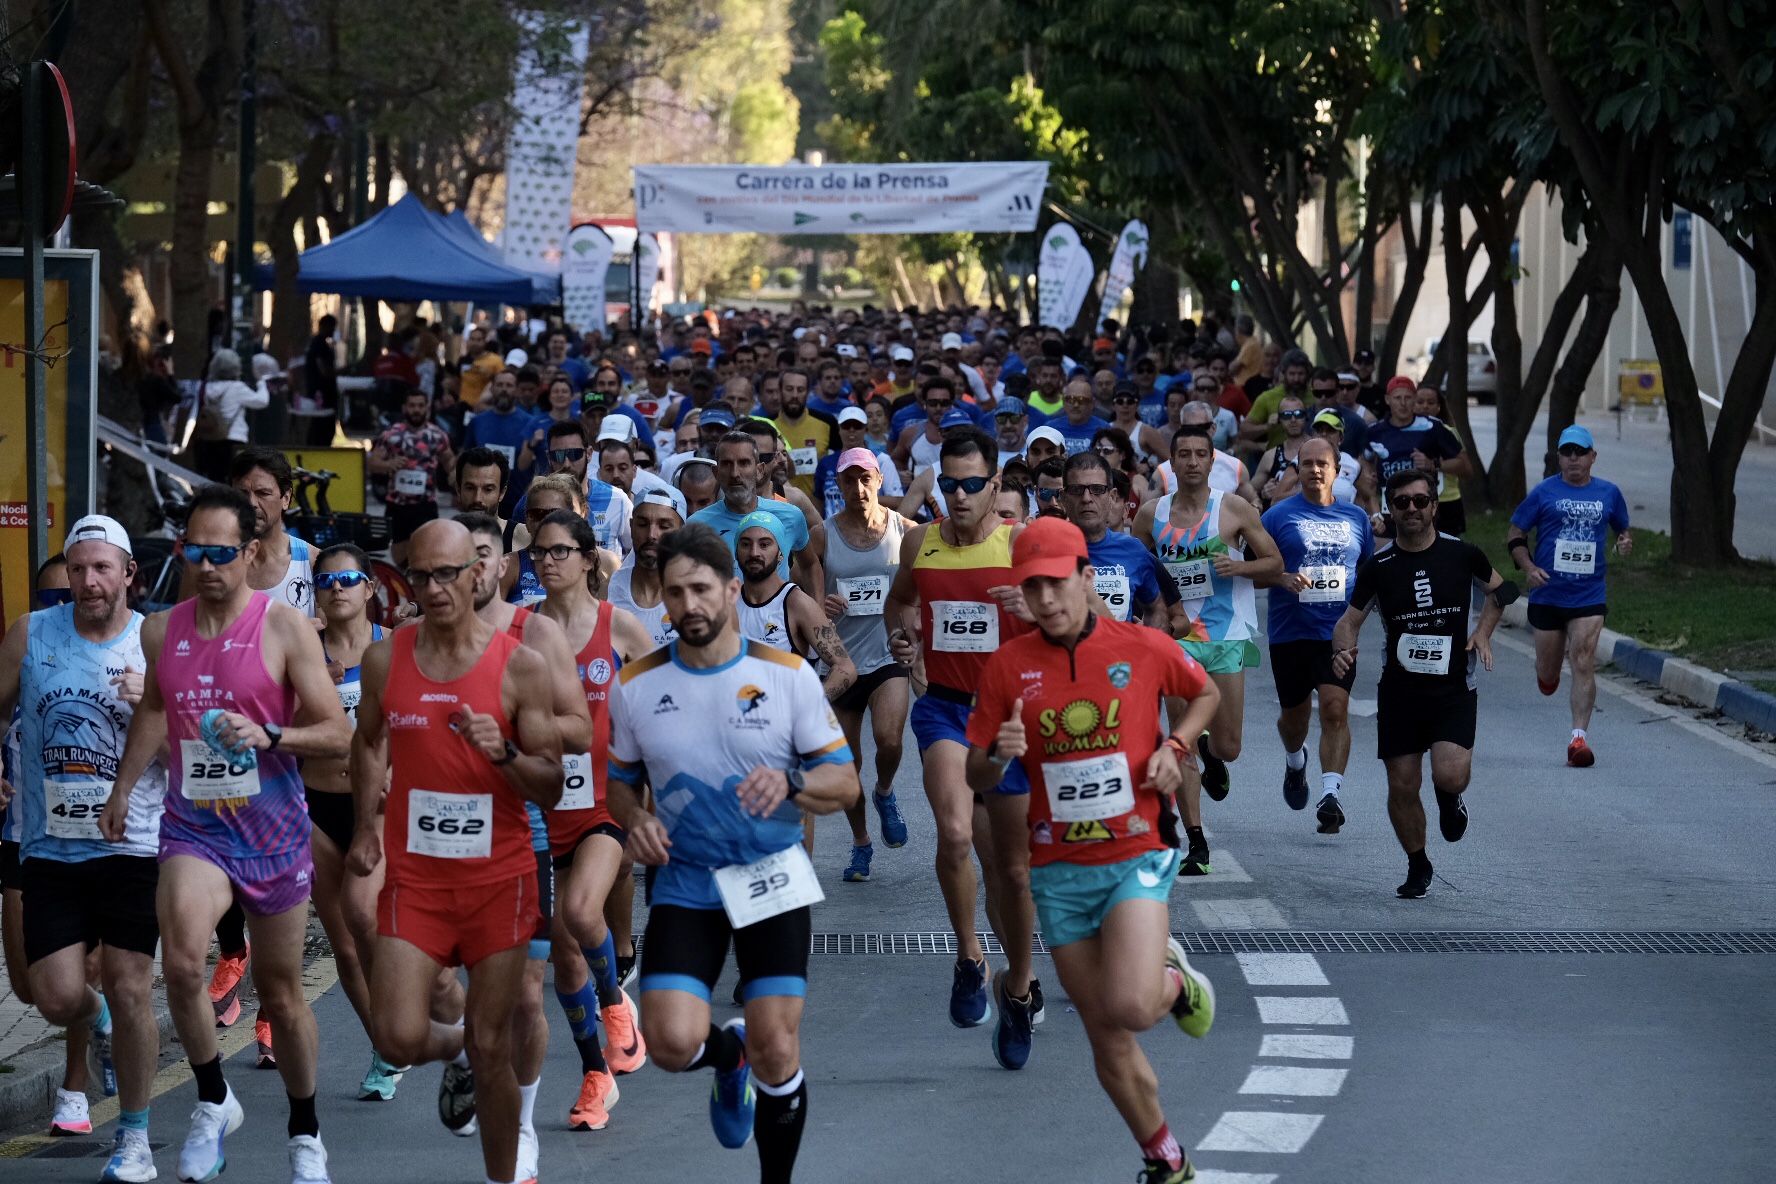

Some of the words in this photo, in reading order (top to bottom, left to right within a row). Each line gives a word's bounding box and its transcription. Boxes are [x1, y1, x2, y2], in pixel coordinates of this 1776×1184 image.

[736, 172, 815, 190] Carrera
[821, 172, 847, 190] de
[853, 172, 871, 190] la
[877, 172, 949, 190] Prensa
[0, 504, 27, 514] Nocil
[1561, 552, 1592, 562] 553
[849, 589, 881, 601] 571
[1097, 593, 1125, 605] 76
[943, 620, 988, 634] 168
[1408, 648, 1443, 661] 185
[36, 687, 74, 717] NUEVA
[175, 688, 234, 703] PAMPA
[588, 691, 606, 701] IDAD
[343, 705, 358, 718] 71
[1044, 732, 1120, 755] WOMAN
[70, 747, 118, 772] RUNNERS
[190, 762, 248, 779] 320
[565, 775, 585, 790] 0
[1058, 777, 1122, 801] 223
[418, 815, 485, 835] 662
[748, 872, 790, 899] 39
